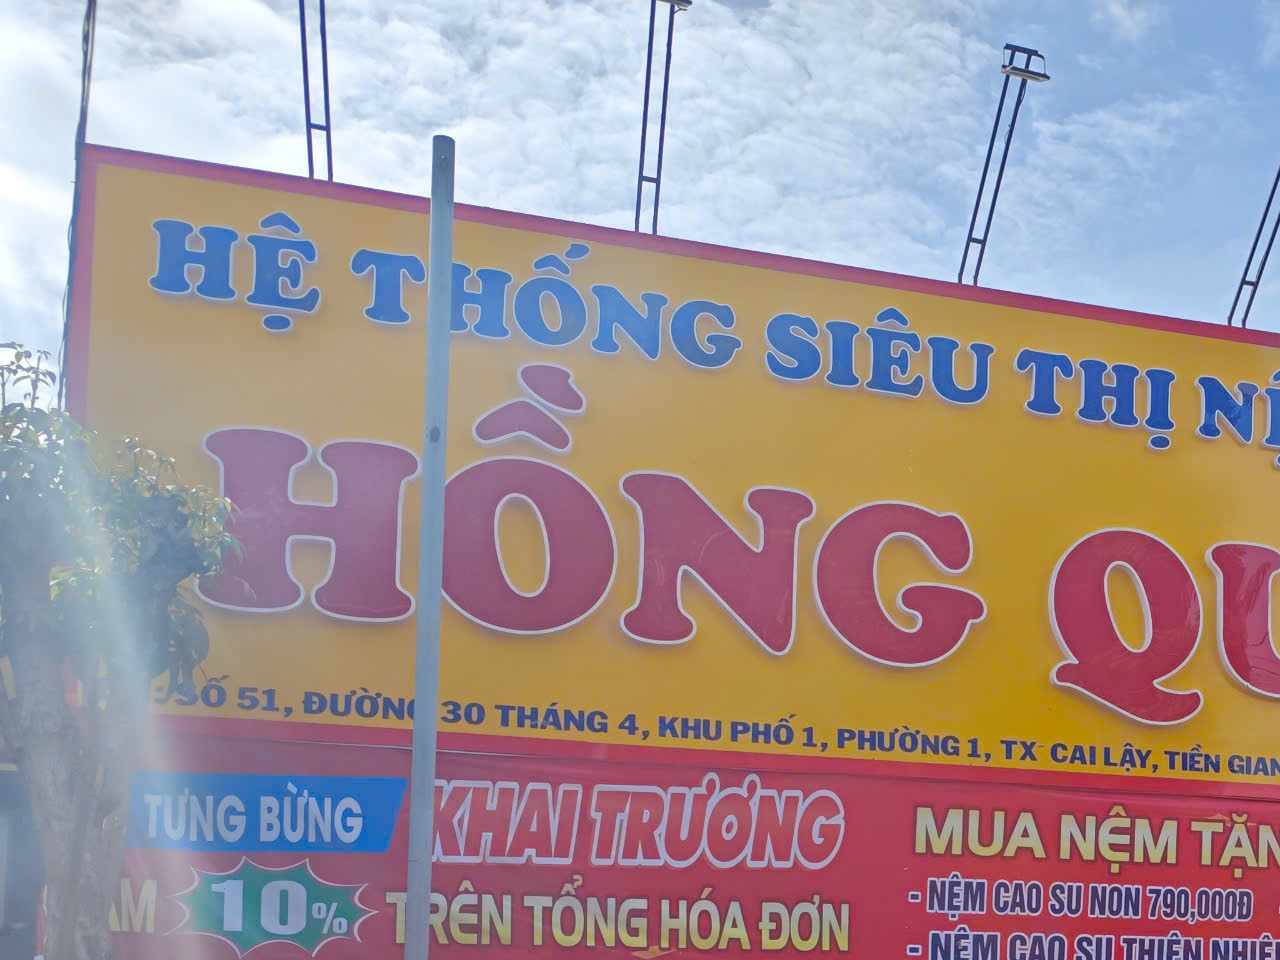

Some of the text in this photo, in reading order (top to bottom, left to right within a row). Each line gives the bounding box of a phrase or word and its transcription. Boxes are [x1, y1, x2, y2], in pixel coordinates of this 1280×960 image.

[149, 210, 320, 332] HỆ
[350, 243, 742, 370] THỐNG
[765, 306, 994, 405] SIÊU
[1014, 347, 1177, 451] THỊ
[194, 362, 988, 668] HỒNG
[236, 687, 294, 718] 51,
[440, 700, 486, 725] 30
[494, 700, 608, 734] THÁNG
[618, 713, 650, 741] 4,
[658, 715, 722, 742] KHU
[730, 713, 797, 746] PHỐ
[802, 726, 829, 753] 1,
[837, 725, 960, 758] PHƯỜNG
[968, 737, 992, 763] 1,
[1000, 739, 1037, 762] TX
[1050, 742, 1097, 766] CAI
[1104, 742, 1159, 775] LẬY,
[1163, 743, 1221, 774] TIỀN
[258, 780, 364, 844] BỪNG
[431, 778, 583, 865] KHAI
[591, 771, 845, 871] TRƯƠNG
[914, 806, 1047, 860] MUA
[1058, 804, 1178, 874] NỆM
[210, 874, 850, 953] 10% TRÊN TỔNG HÓA ĐƠN
[927, 873, 987, 920] NỆM
[992, 881, 1043, 916] CAO
[1048, 882, 1084, 918] SU
[1088, 885, 1142, 920] NON
[1147, 887, 1253, 924] 790,000Đ
